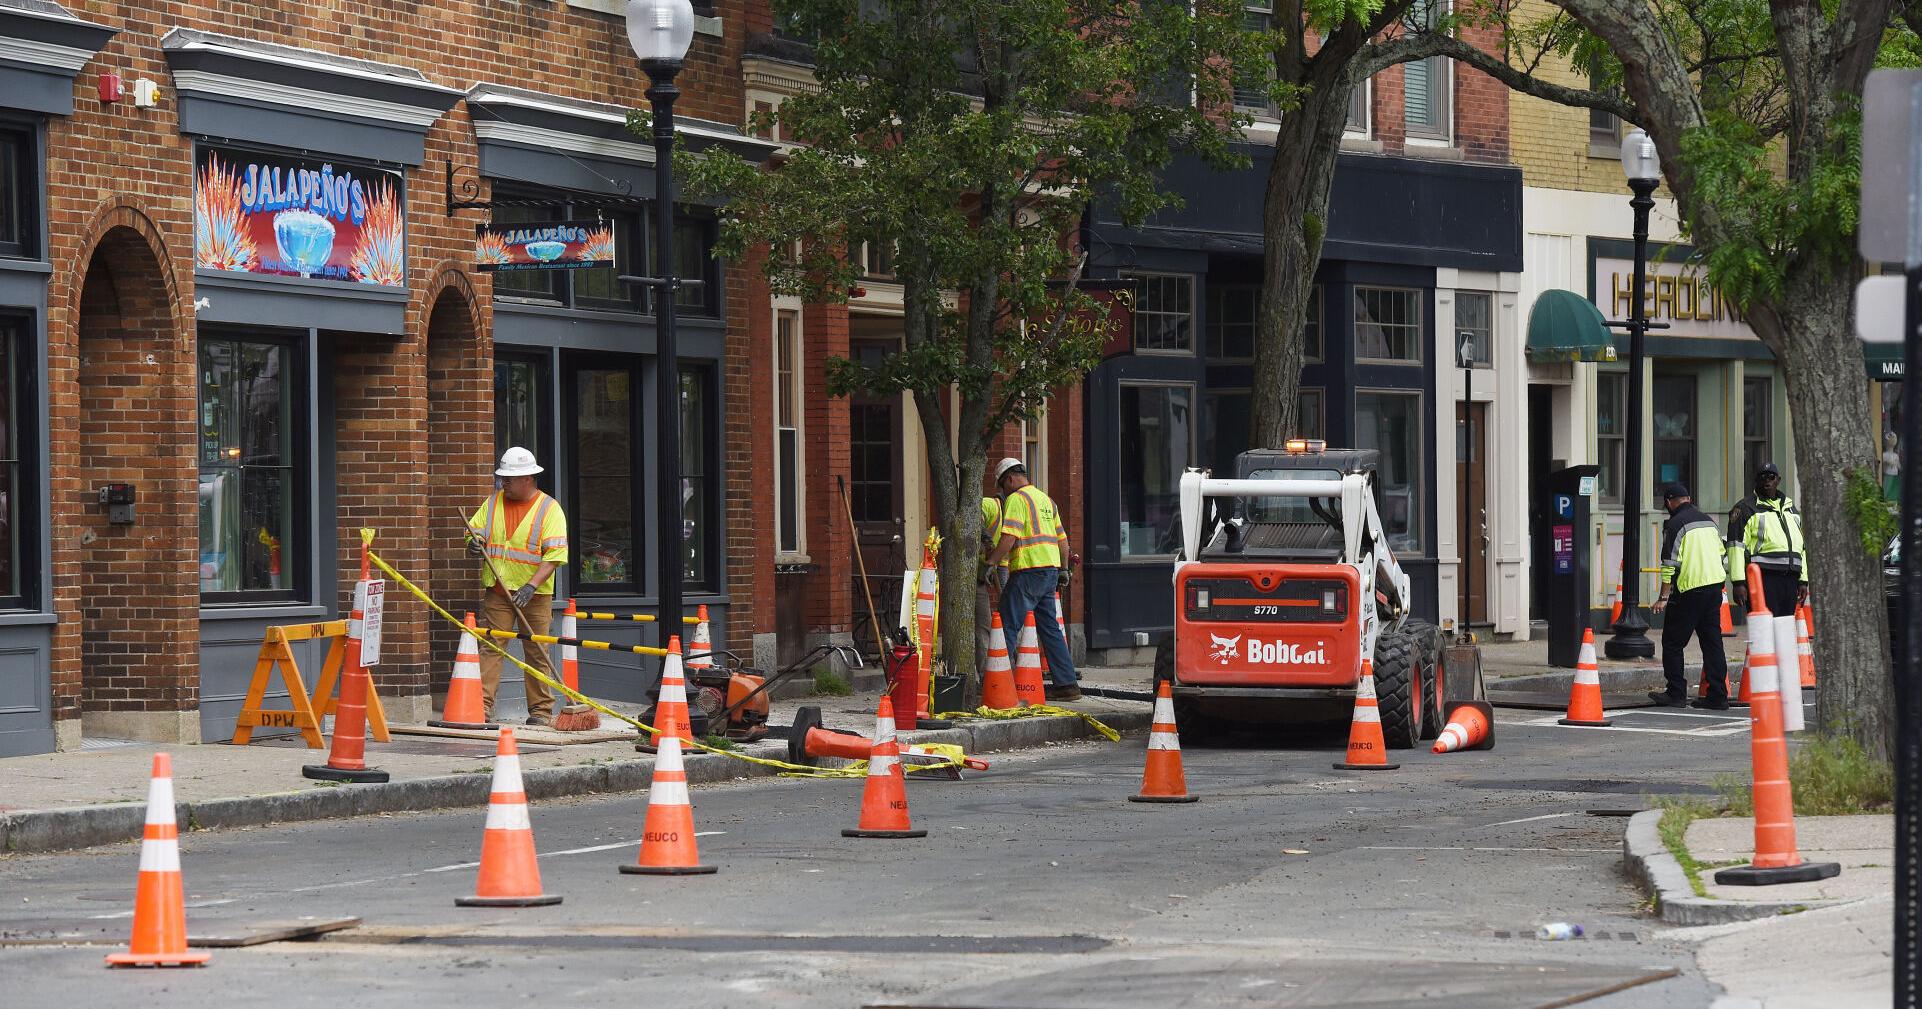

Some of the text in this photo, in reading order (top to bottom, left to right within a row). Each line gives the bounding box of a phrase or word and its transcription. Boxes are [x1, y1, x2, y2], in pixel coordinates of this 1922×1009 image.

[242, 163, 365, 224] JALAPEÑO'S
[504, 225, 587, 246] JALAPEÑO'S
[1882, 362, 1905, 375] MAI
[1254, 605, 1278, 615] S770
[311, 623, 325, 637] DPW
[261, 713, 295, 727] DPW
[643, 831, 679, 842] NEUCO
